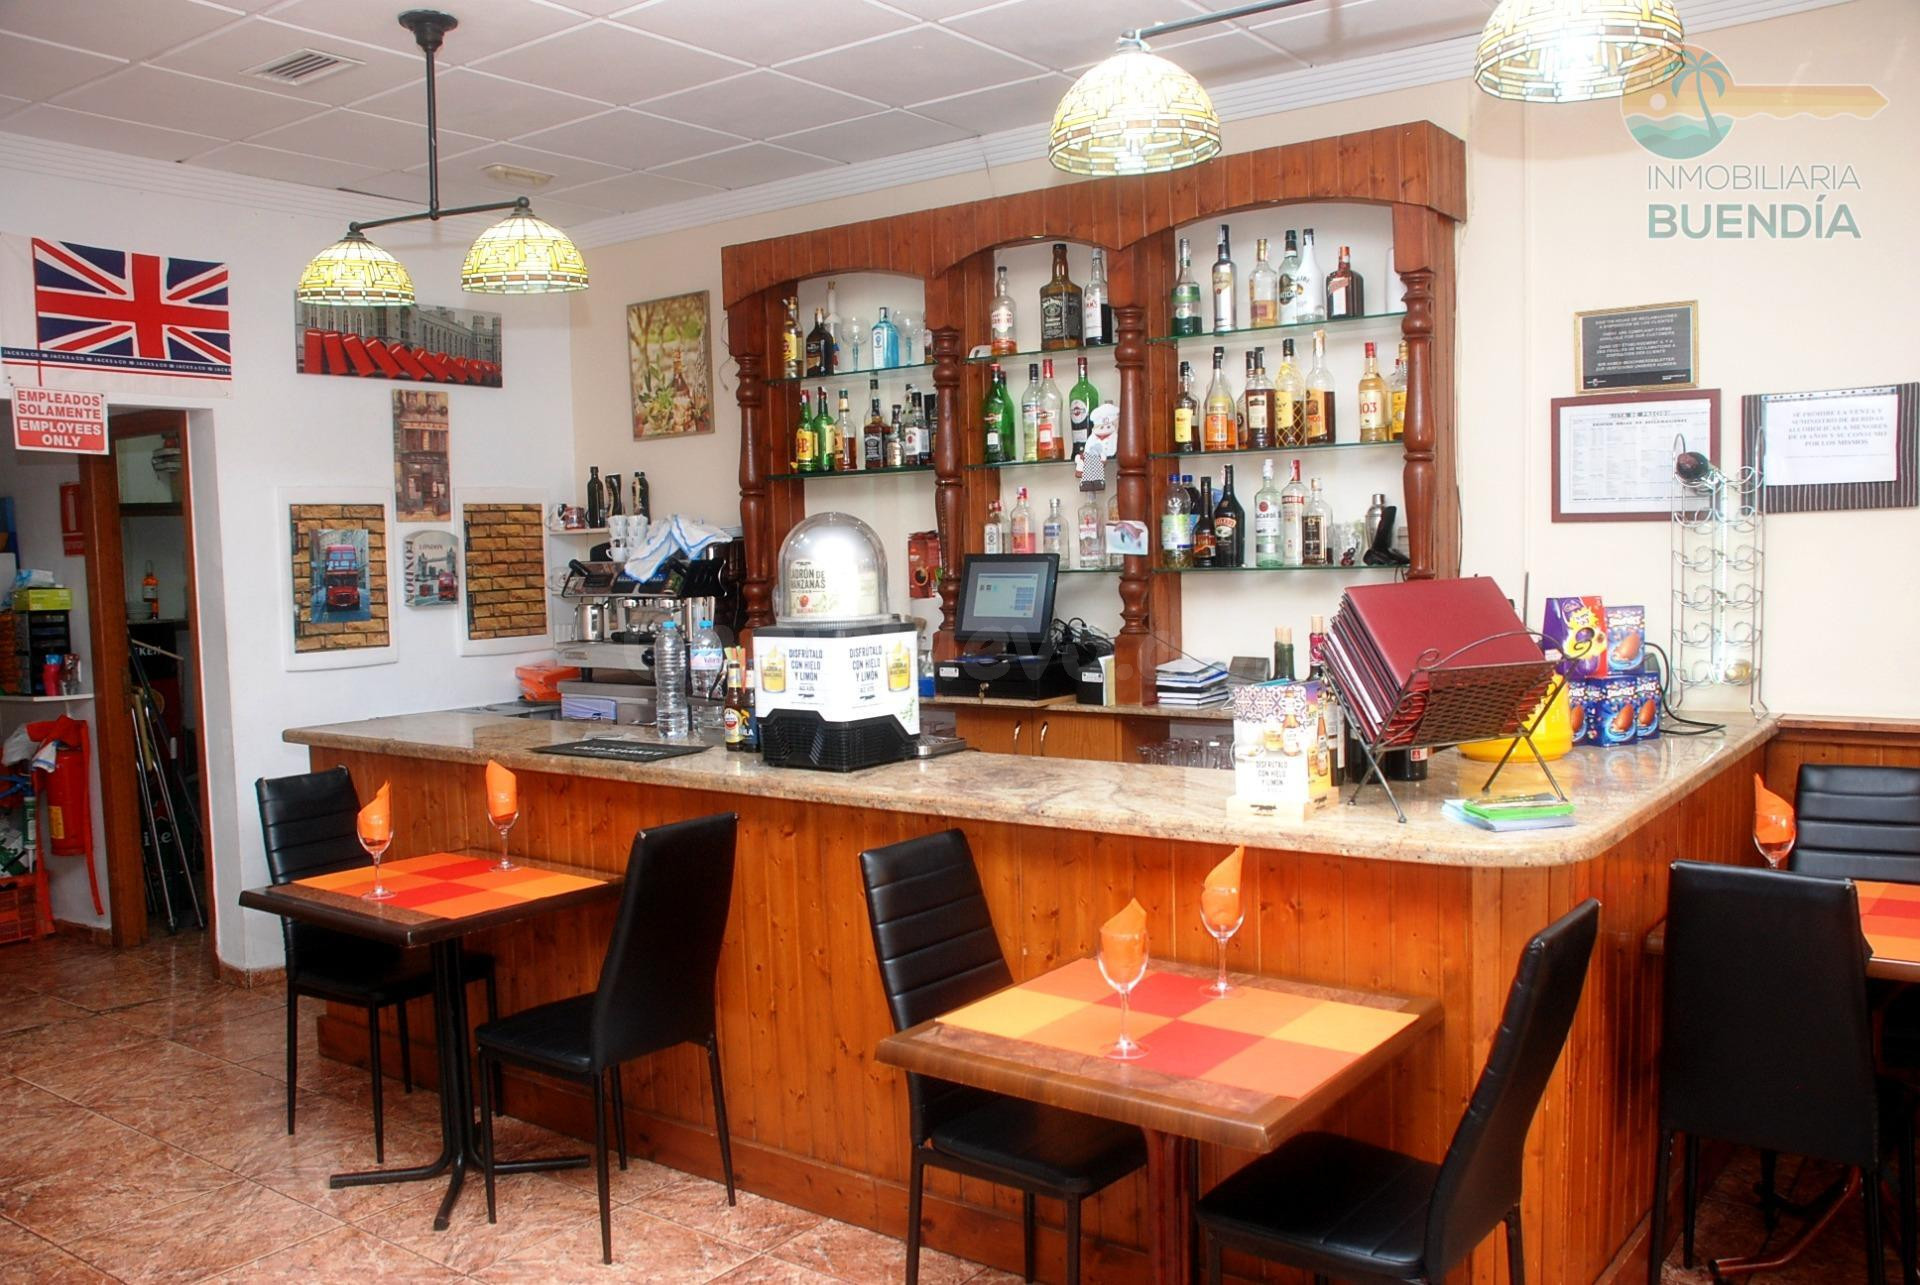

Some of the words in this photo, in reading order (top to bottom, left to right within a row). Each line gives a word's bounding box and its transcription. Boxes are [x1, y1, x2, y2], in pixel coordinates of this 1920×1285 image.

[17, 390, 100, 407] EMPLEADOS
[18, 403, 101, 420] SOLAMENTE
[20, 421, 102, 436] EMPLOYEES
[42, 434, 81, 448] ONLY
[404, 540, 416, 604] LONDON
[788, 647, 823, 659] DISFRÚTALO
[849, 644, 883, 659] DISFRÚTALO
[790, 660, 803, 670] CON
[804, 660, 821, 670] HIELO
[852, 660, 864, 670] CON
[865, 658, 881, 669] HIELO
[794, 672, 799, 681] Y
[800, 671, 818, 681] LIMÓN
[855, 673, 860, 682] Y
[861, 671, 879, 682] LIMÓN
